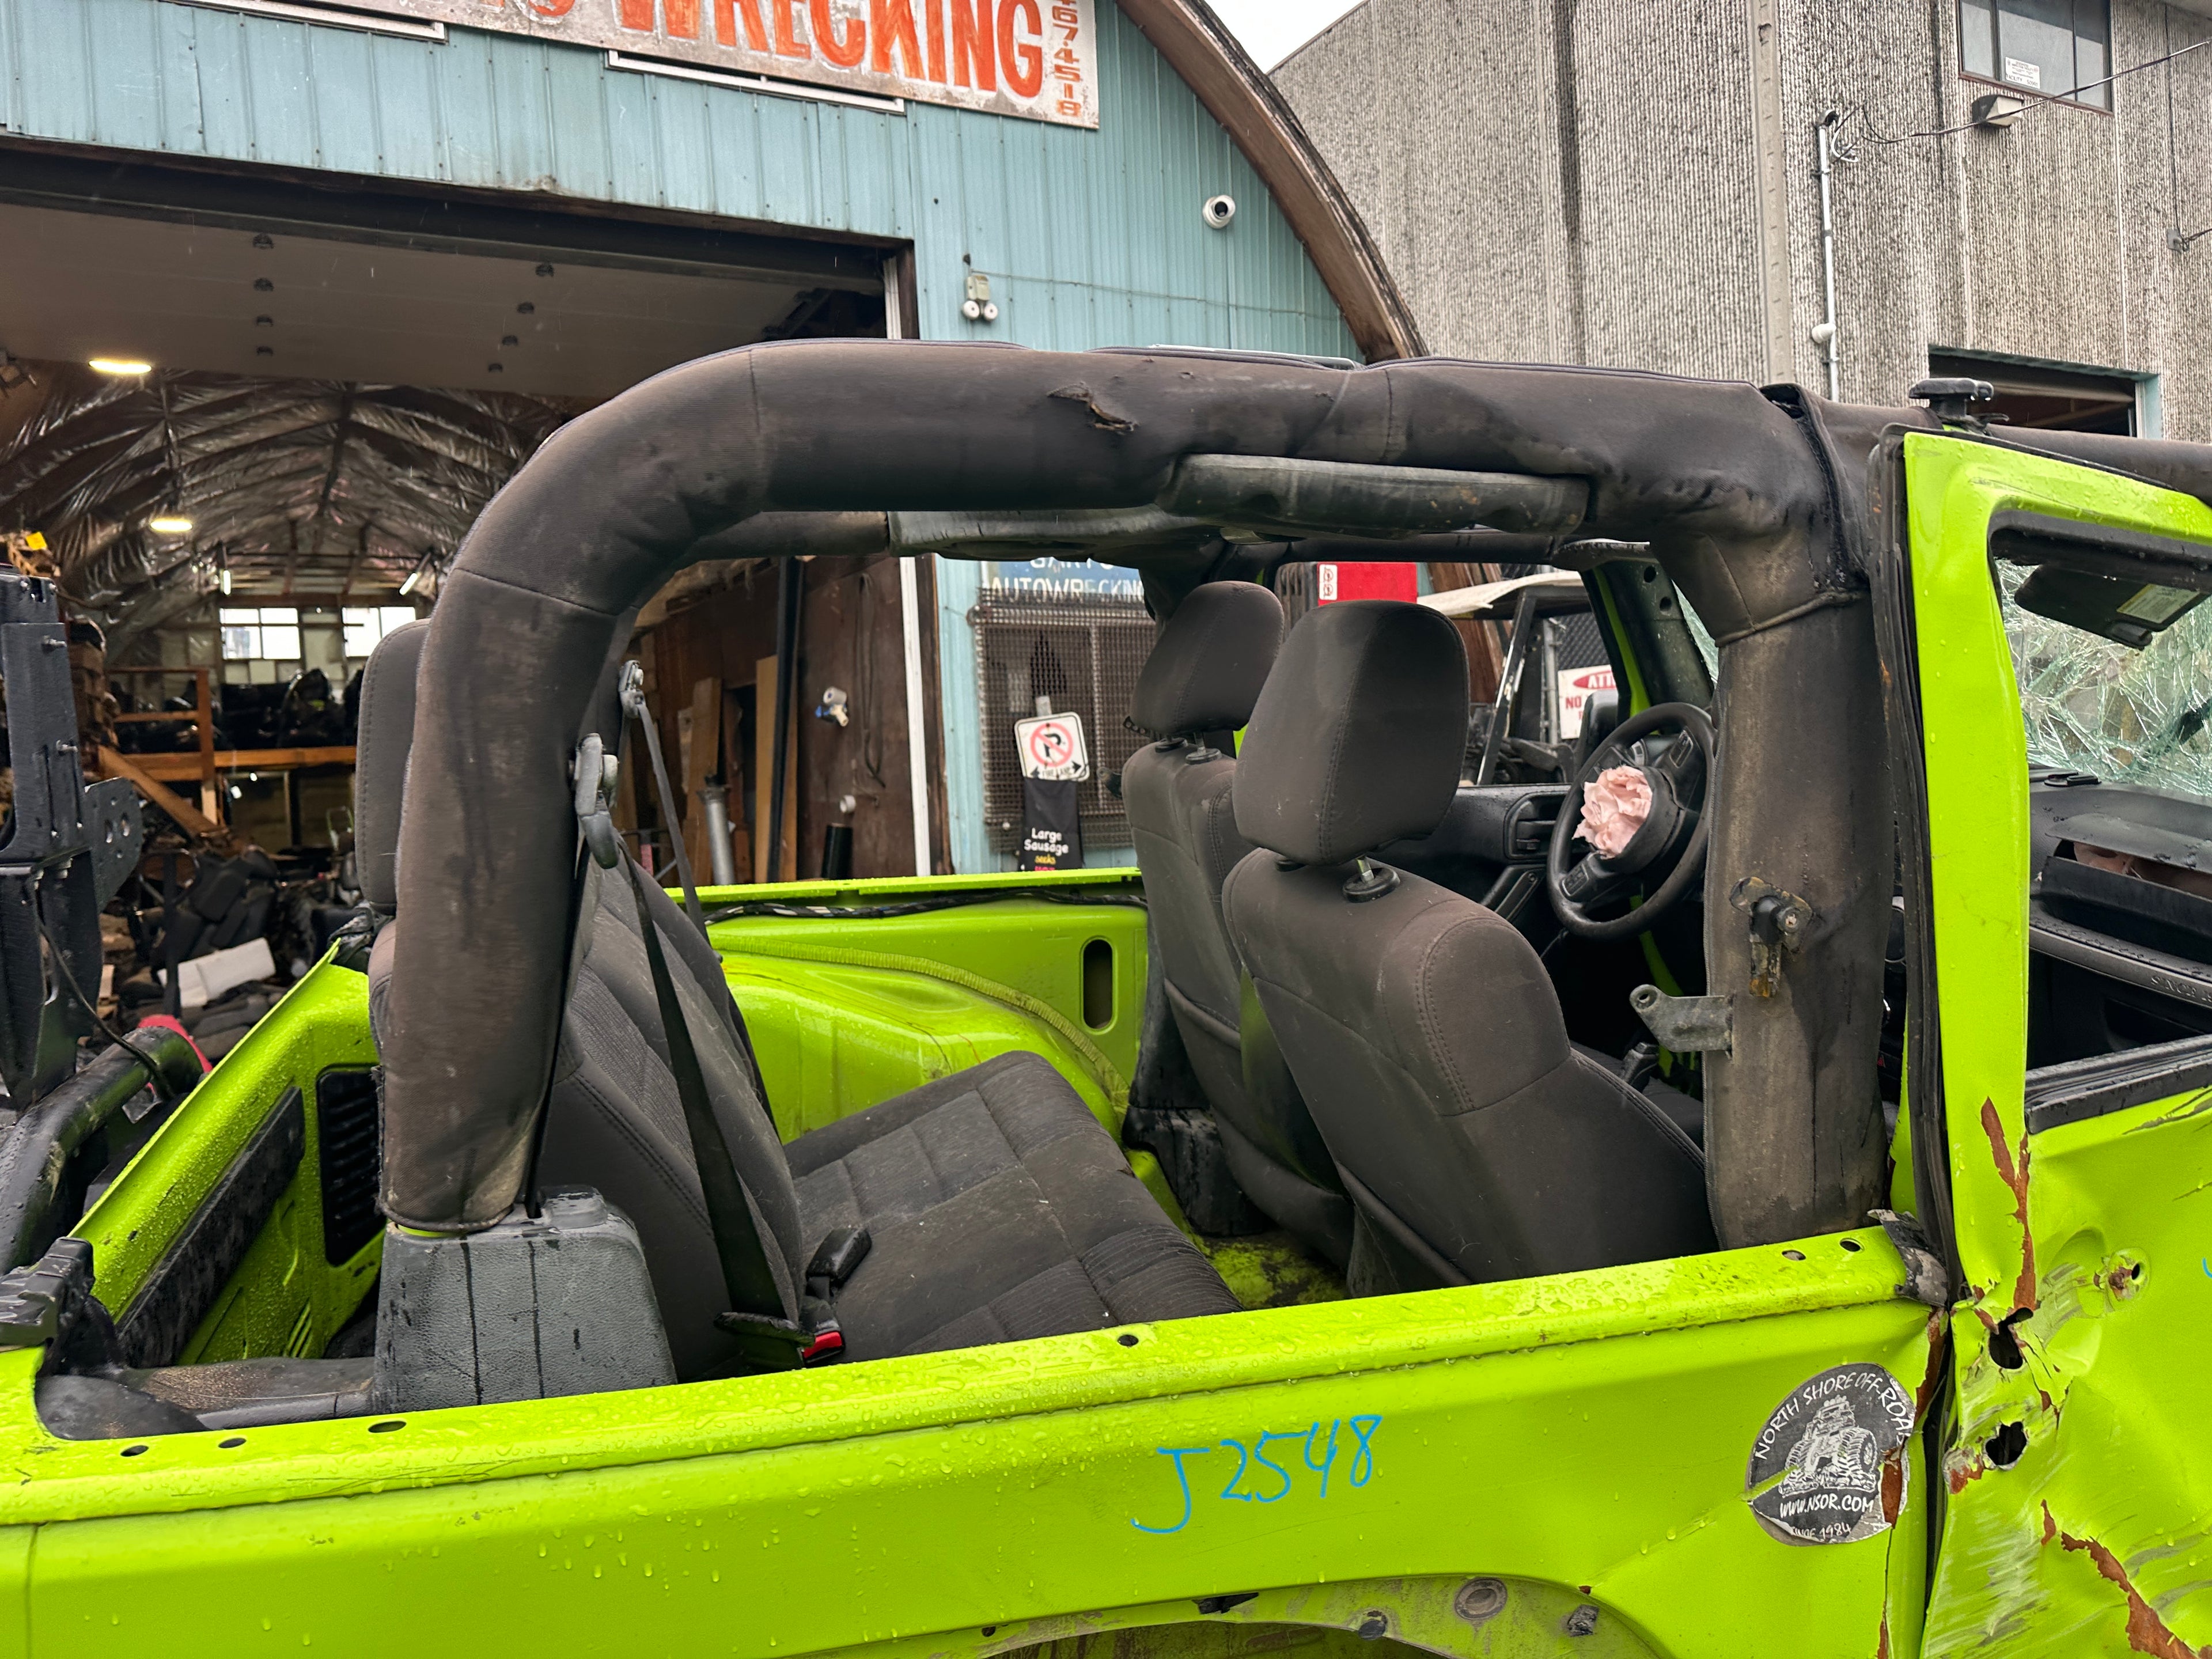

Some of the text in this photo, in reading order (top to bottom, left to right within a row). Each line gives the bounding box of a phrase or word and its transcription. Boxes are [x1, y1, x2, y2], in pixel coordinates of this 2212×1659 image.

[1565, 696, 1582, 710] NO
[1031, 827, 1062, 844] Large
[1024, 839, 1069, 857] Sausage
[1754, 1397, 1800, 1460] NORTH
[1802, 1372, 1857, 1406] SHORE
[1779, 1493, 1874, 1519] WWW.NSOR.COM
[1819, 1521, 1851, 1540] 1984
